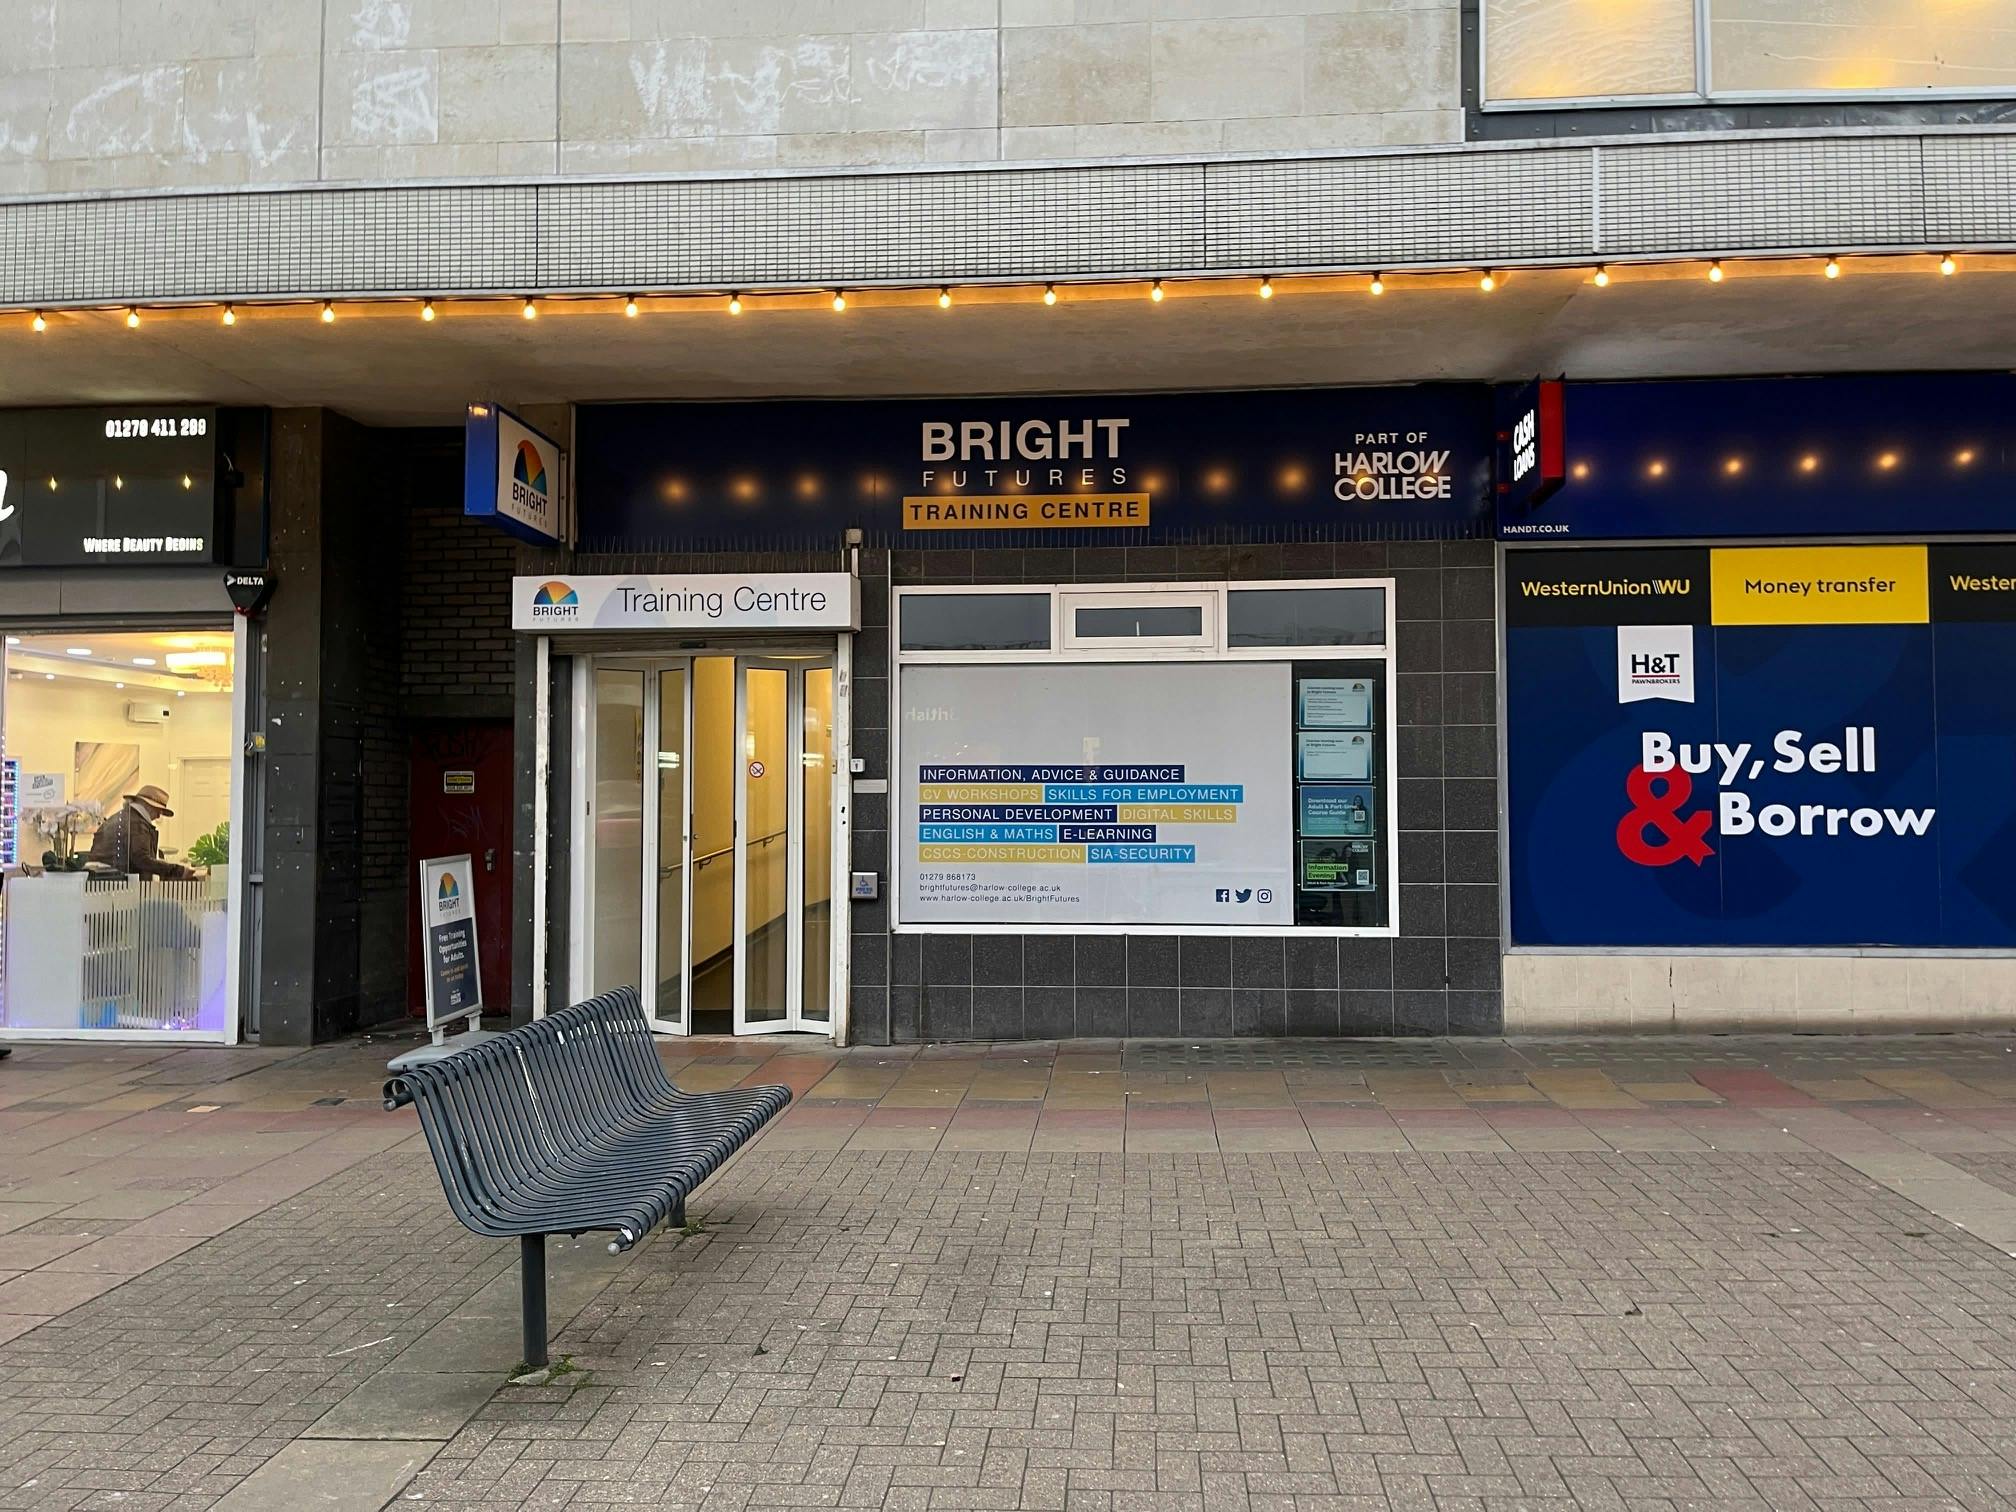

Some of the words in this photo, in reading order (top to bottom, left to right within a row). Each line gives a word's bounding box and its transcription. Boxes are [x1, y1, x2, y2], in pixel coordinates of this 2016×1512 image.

[151, 418, 178, 437] 411
[1513, 408, 1535, 454] CASH
[922, 418, 1130, 462] BRIGHT
[1355, 432, 1399, 445] PART
[1406, 431, 1428, 444] OF
[1334, 450, 1450, 475] HARLOW
[1513, 441, 1536, 481] LOANS
[922, 467, 1127, 488] FUTURES
[1334, 475, 1451, 501] COLLEGE
[512, 481, 548, 516] BRIGHT
[910, 503, 1028, 521] TRAINING
[1041, 501, 1140, 519] CENTRE
[1503, 524, 1570, 534] HANDT.CO.UK
[237, 576, 264, 586] DELTA
[1521, 578, 1652, 598] WesternUnion
[1745, 577, 1811, 597] Money
[1816, 577, 1896, 594] transfer
[616, 587, 723, 618] Training
[733, 586, 827, 612] Centre
[533, 606, 579, 616] BRIGHT
[1631, 653, 1680, 674] H&T
[1642, 732, 1765, 786] Buy,
[1773, 726, 1876, 773] Sell
[922, 769, 1026, 782] INFORMATION,
[1031, 769, 1084, 780] ADVICE
[1089, 769, 1098, 780] &
[1103, 768, 1180, 780] GUIDANCE
[922, 788, 941, 800] CV
[947, 788, 1039, 800] WORKSHOPS
[1048, 788, 1097, 800] SKILLS
[1102, 788, 1132, 800] FOR
[1137, 788, 1239, 800] EMPLOYMENT
[922, 808, 1000, 820] PERSONAL
[1005, 808, 1113, 820] DEVELOPMENT
[1122, 808, 1178, 820] DIGITAL
[1183, 808, 1233, 820] SKILLS
[1719, 792, 1936, 836] Borrow
[922, 828, 985, 840] ENGLISH
[990, 829, 999, 840] &
[1004, 828, 1054, 840] MATHS
[1063, 828, 1153, 840] E-LEARNING
[922, 847, 1081, 859] CSCS-CONSTRUCTION
[1090, 848, 1193, 860] SIA-SECURITY
[919, 873, 944, 881] 01279
[946, 873, 976, 881] 868173
[438, 897, 460, 912] BRIGHT
